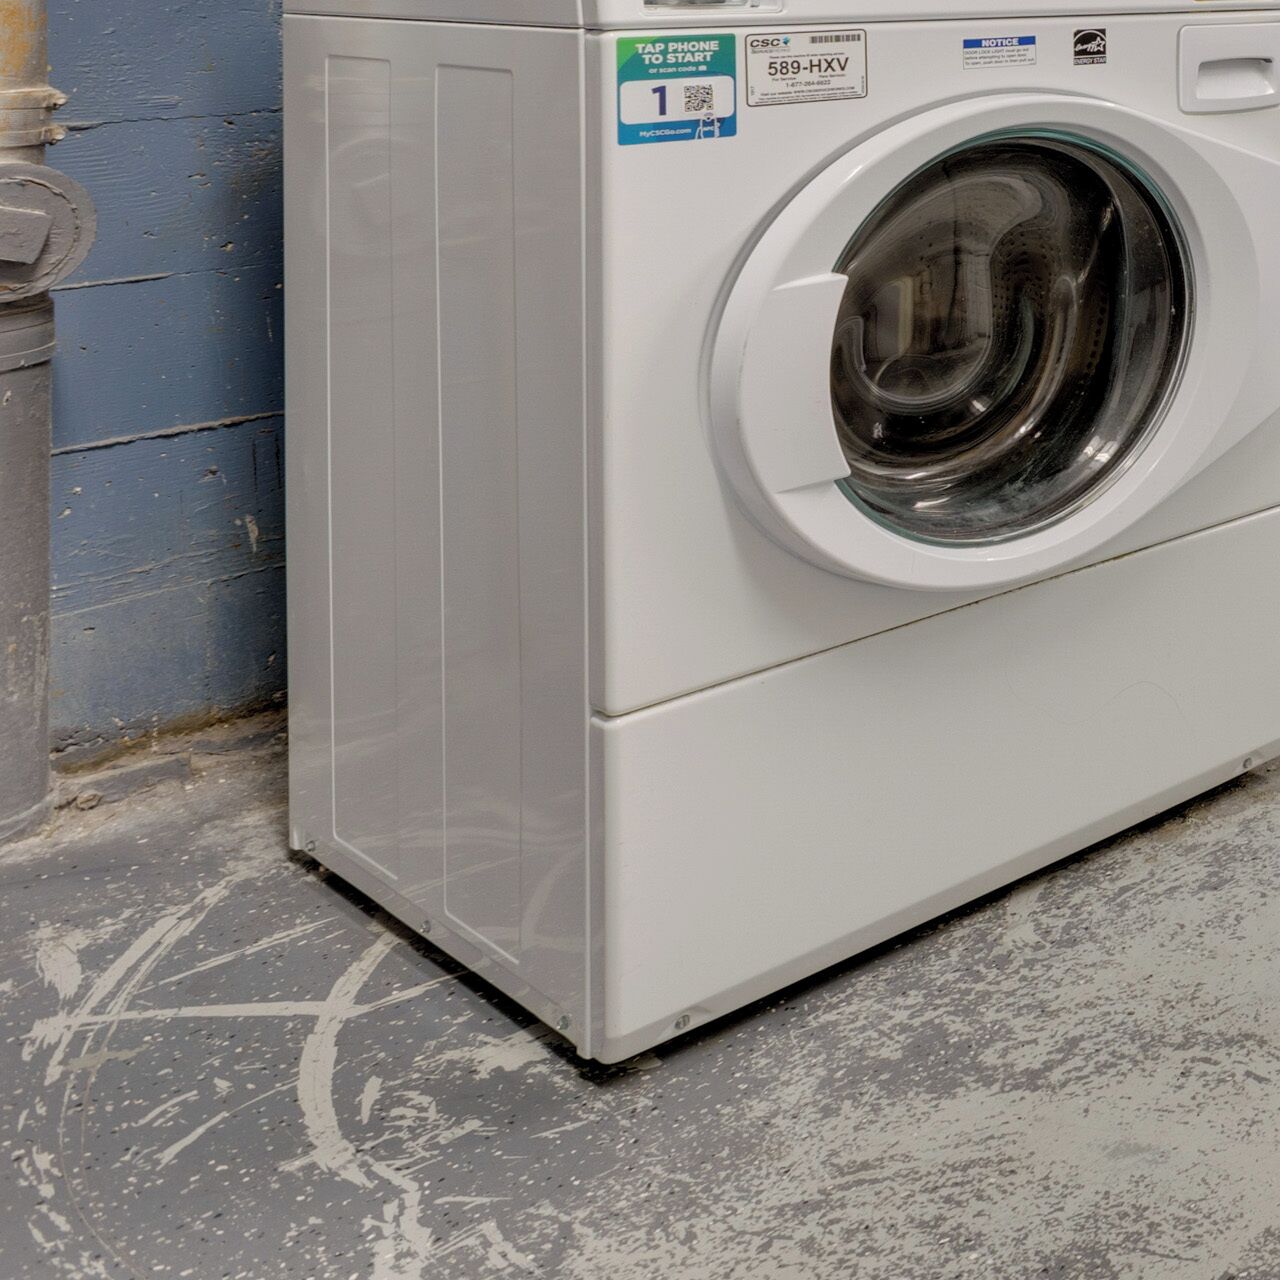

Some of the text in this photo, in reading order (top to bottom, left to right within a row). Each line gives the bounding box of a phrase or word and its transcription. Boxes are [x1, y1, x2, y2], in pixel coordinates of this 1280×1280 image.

[635, 41, 720, 54] TAP PHONE
[750, 39, 780, 47] CSC
[982, 38, 1019, 46] NOTICE
[642, 52, 714, 65] TO START
[768, 57, 849, 76] 589-HXV
[651, 85, 667, 116] 1
